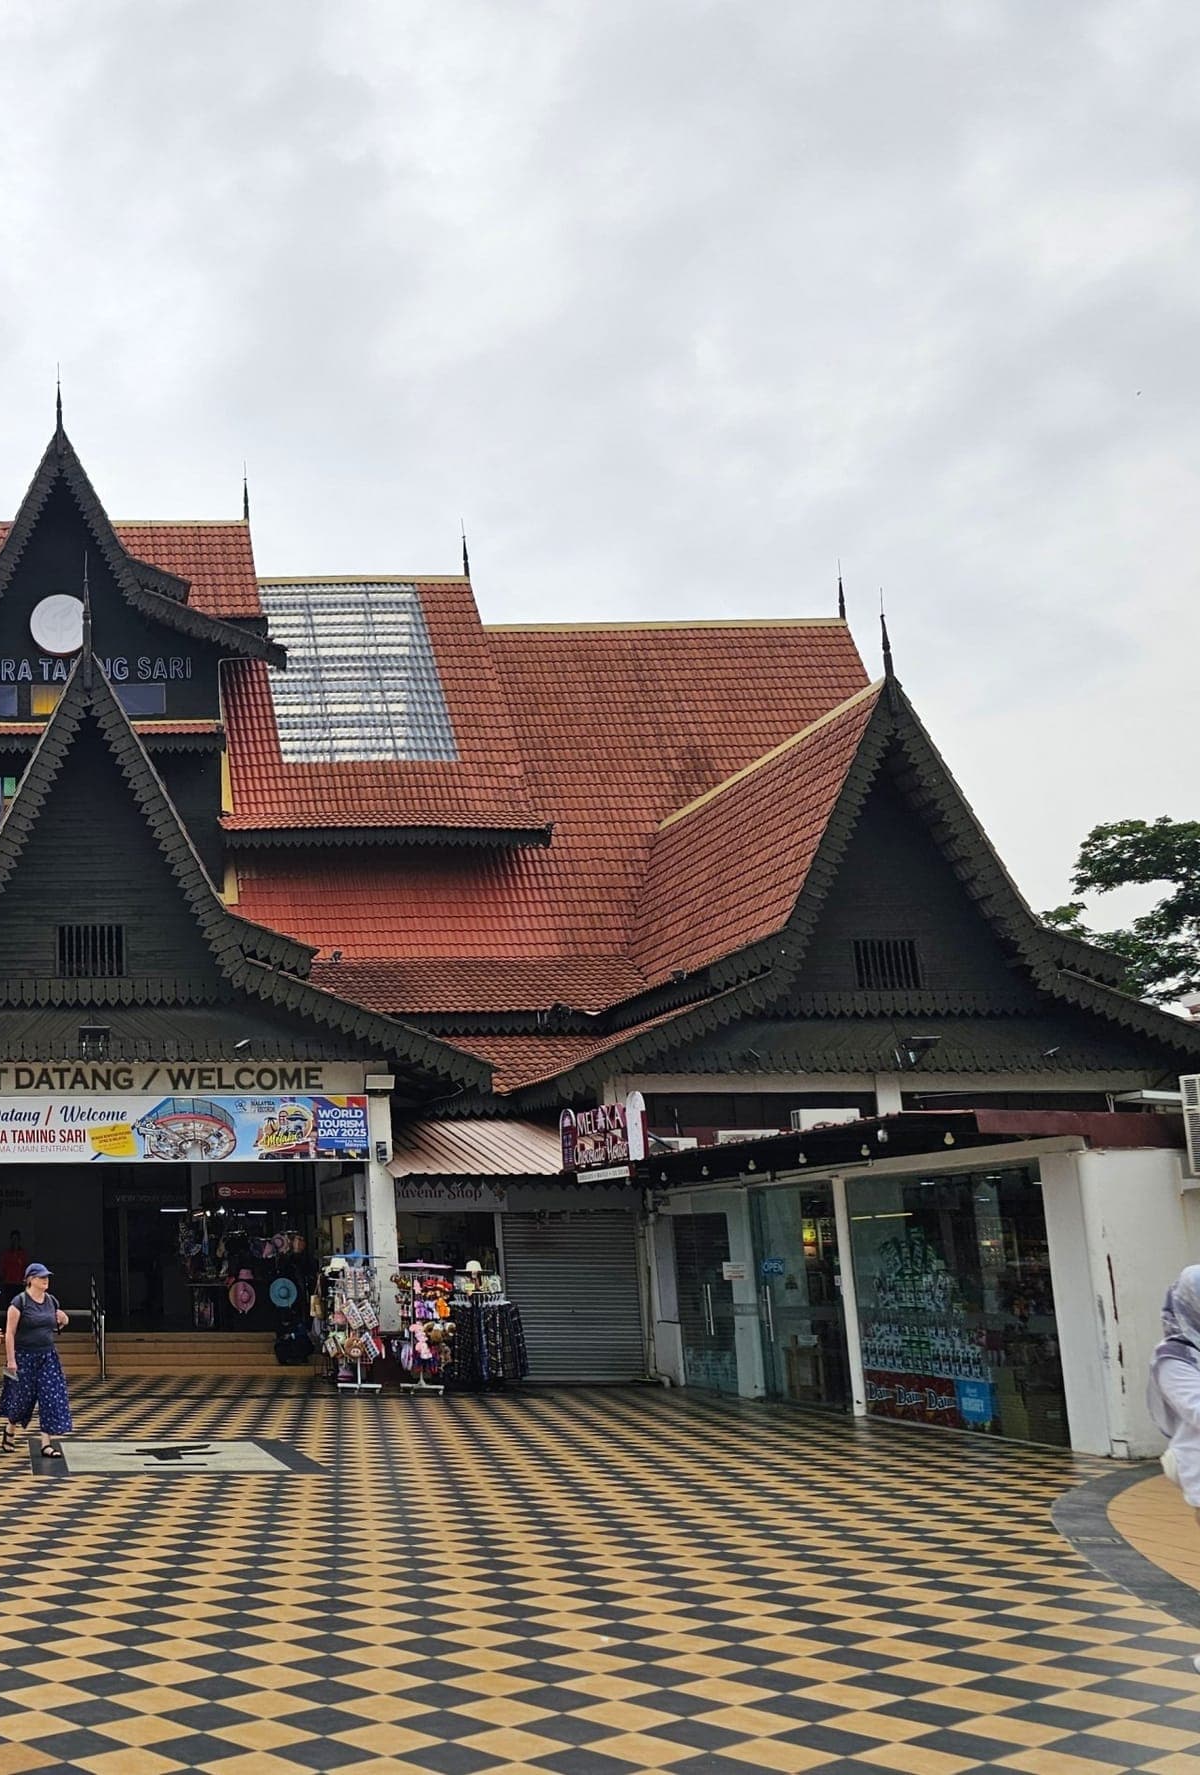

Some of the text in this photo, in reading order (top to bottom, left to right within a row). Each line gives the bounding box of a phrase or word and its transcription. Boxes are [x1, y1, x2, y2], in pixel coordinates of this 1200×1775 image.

[38, 657, 129, 681] TANG
[137, 656, 192, 680] SARI
[14, 1067, 134, 1090] DATANG
[169, 1066, 324, 1090] WELCOME
[59, 1105, 128, 1122] Welcome
[318, 1108, 364, 1119] WORLD
[577, 1104, 625, 1137] MELAKA
[318, 1119, 365, 1128] TOURISM
[10, 1129, 56, 1144] TAMING
[59, 1128, 87, 1143] SARI
[318, 1128, 367, 1137] DAY 2025
[17, 1145, 39, 1153] MAIN
[39, 1144, 85, 1153] ENTRANCE
[762, 1260, 784, 1274] OPEN
